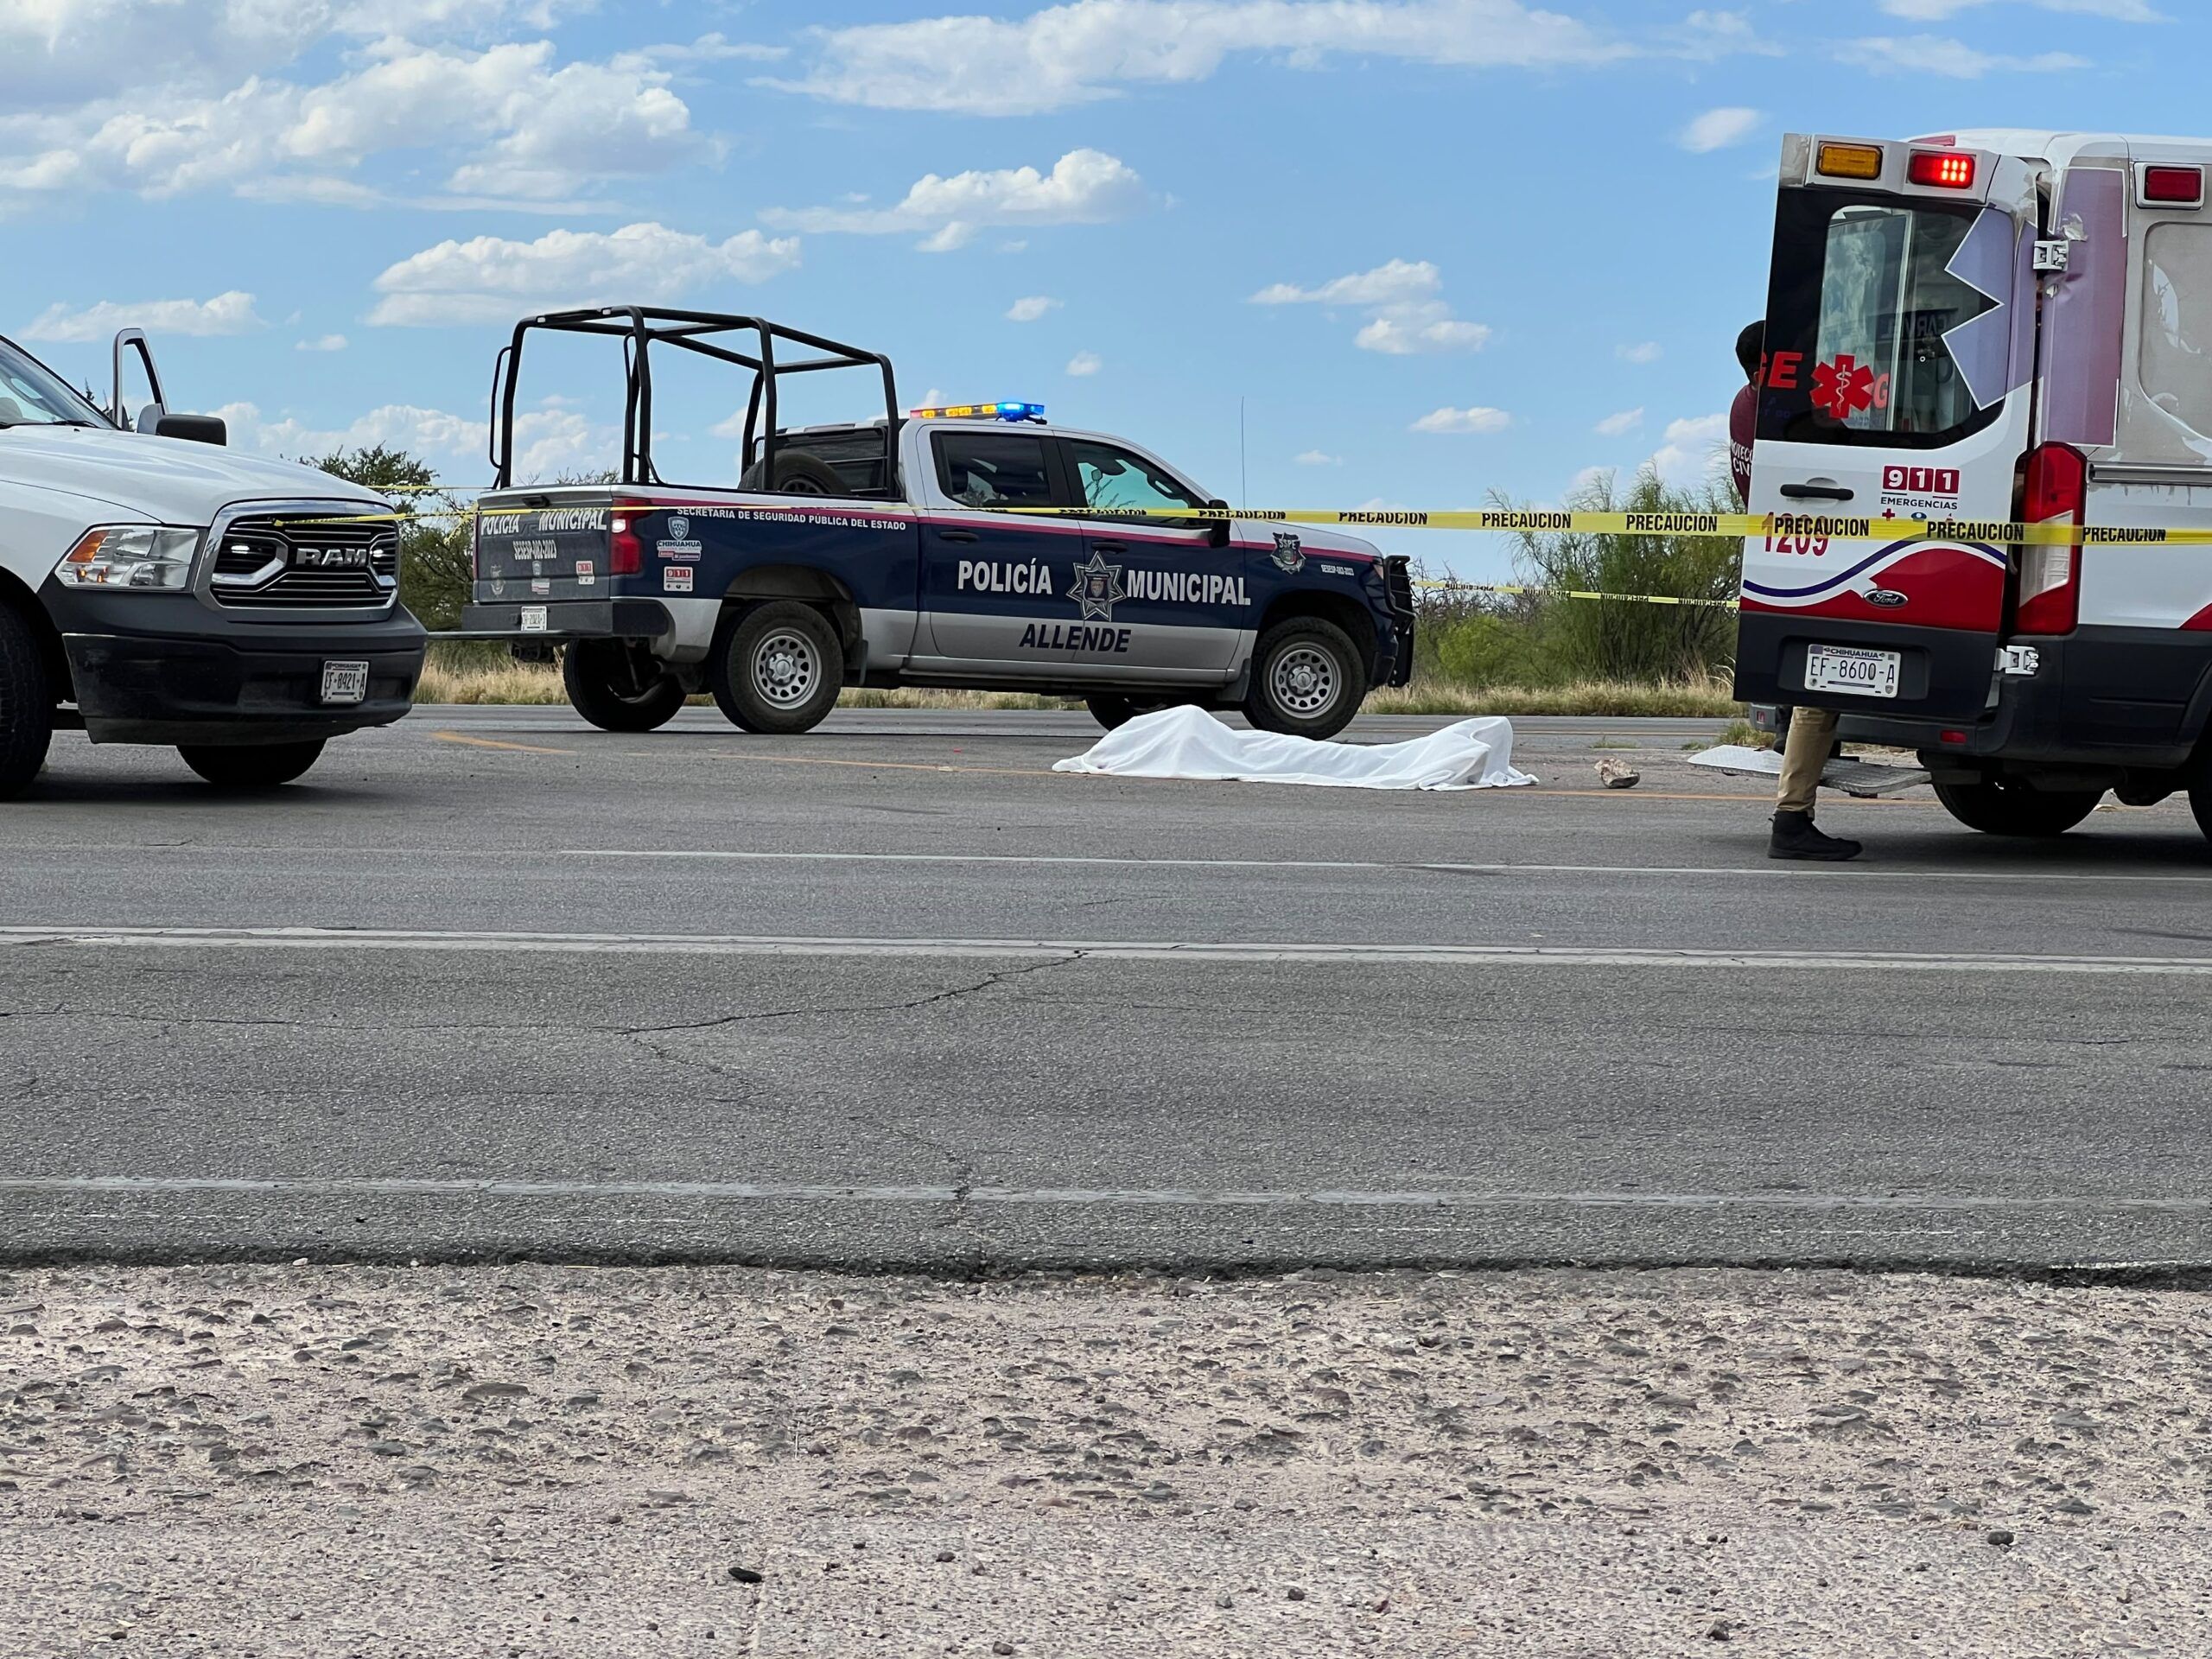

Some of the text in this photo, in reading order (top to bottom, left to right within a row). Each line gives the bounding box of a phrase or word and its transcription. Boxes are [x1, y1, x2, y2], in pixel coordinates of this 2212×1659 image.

[1887, 468, 1954, 491] 911
[1880, 496, 1958, 510] EMERGENCIAS
[538, 510, 607, 531] MUNICIPAL
[753, 512, 806, 523] SEGURIDAD
[809, 513, 848, 527] PÚBLICA
[851, 518, 868, 528] DEL
[871, 520, 906, 531] ESTADO
[1338, 511, 1428, 525] PRECAUCION
[1481, 512, 1572, 529] PRECAUCION
[1625, 514, 1718, 532] PRECAUCION
[1774, 517, 1869, 537] PRECAUCION
[1927, 521, 2024, 541] PRECAUCION
[2082, 526, 2166, 543] PRECAUCION
[1279, 538, 1296, 550] SSPE
[1761, 512, 1829, 556] 1209
[296, 547, 367, 567] RAM
[957, 557, 1251, 606] POLICÍA MUNICIPAL
[1873, 593, 1899, 604] Ford
[1020, 624, 1131, 652] ALLENDE
[1830, 648, 1879, 658] CHIHUAHUA
[1810, 657, 1895, 683] EF-8600-A
